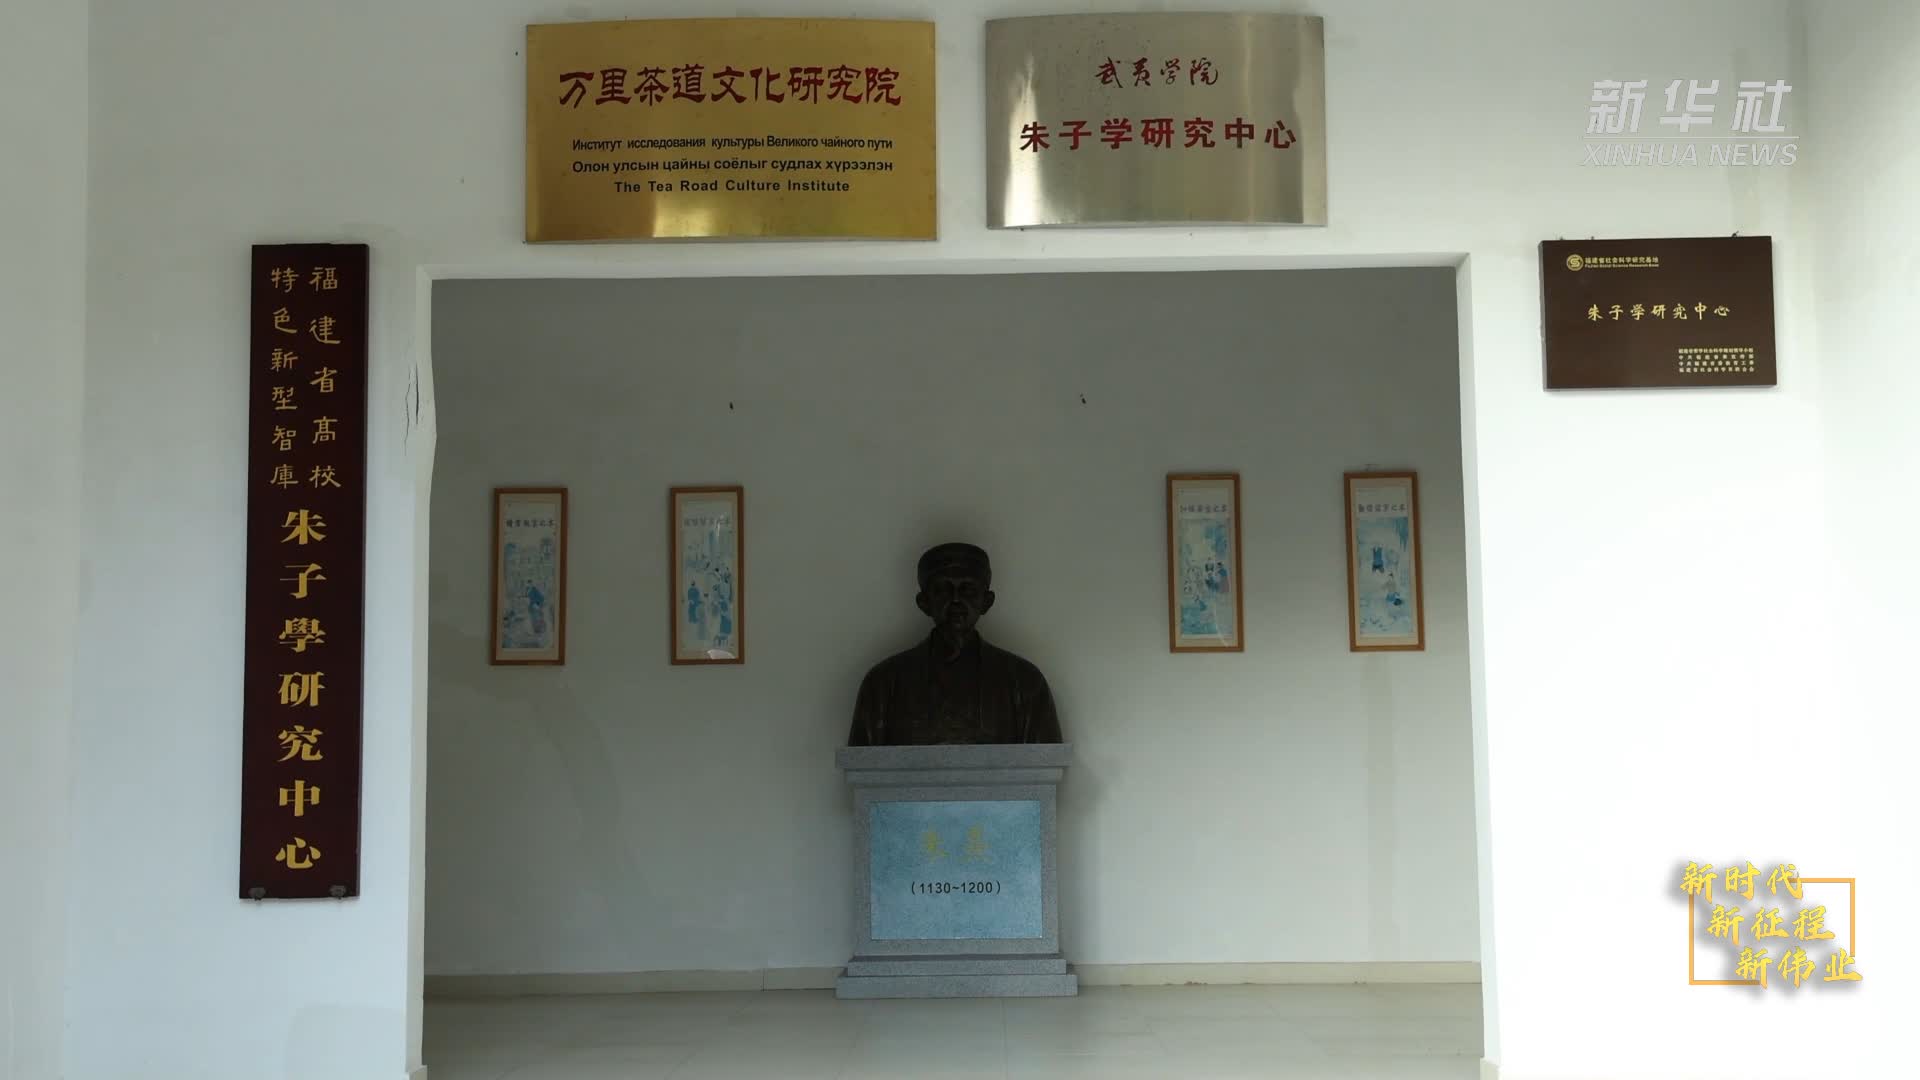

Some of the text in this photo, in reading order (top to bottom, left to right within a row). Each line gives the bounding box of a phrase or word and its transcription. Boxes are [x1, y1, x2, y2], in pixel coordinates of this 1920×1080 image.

[1095, 56, 1219, 89] 武夷学院
[559, 63, 902, 109] 万里茶道文化研究院
[572, 135, 893, 152] Институт исследования культуры Великого чайного пути
[1019, 116, 1297, 152] 朱子学研究中心
[572, 157, 893, 174] Олон улсын цайны соёлыг судлах хүрээлэн
[614, 179, 850, 193] The Tea Road Culture Institute
[1586, 301, 1731, 321] 朱子学研究中心
[275, 508, 327, 870] 朱子學研究中心
[911, 880, 1001, 895] (1130~1200)
